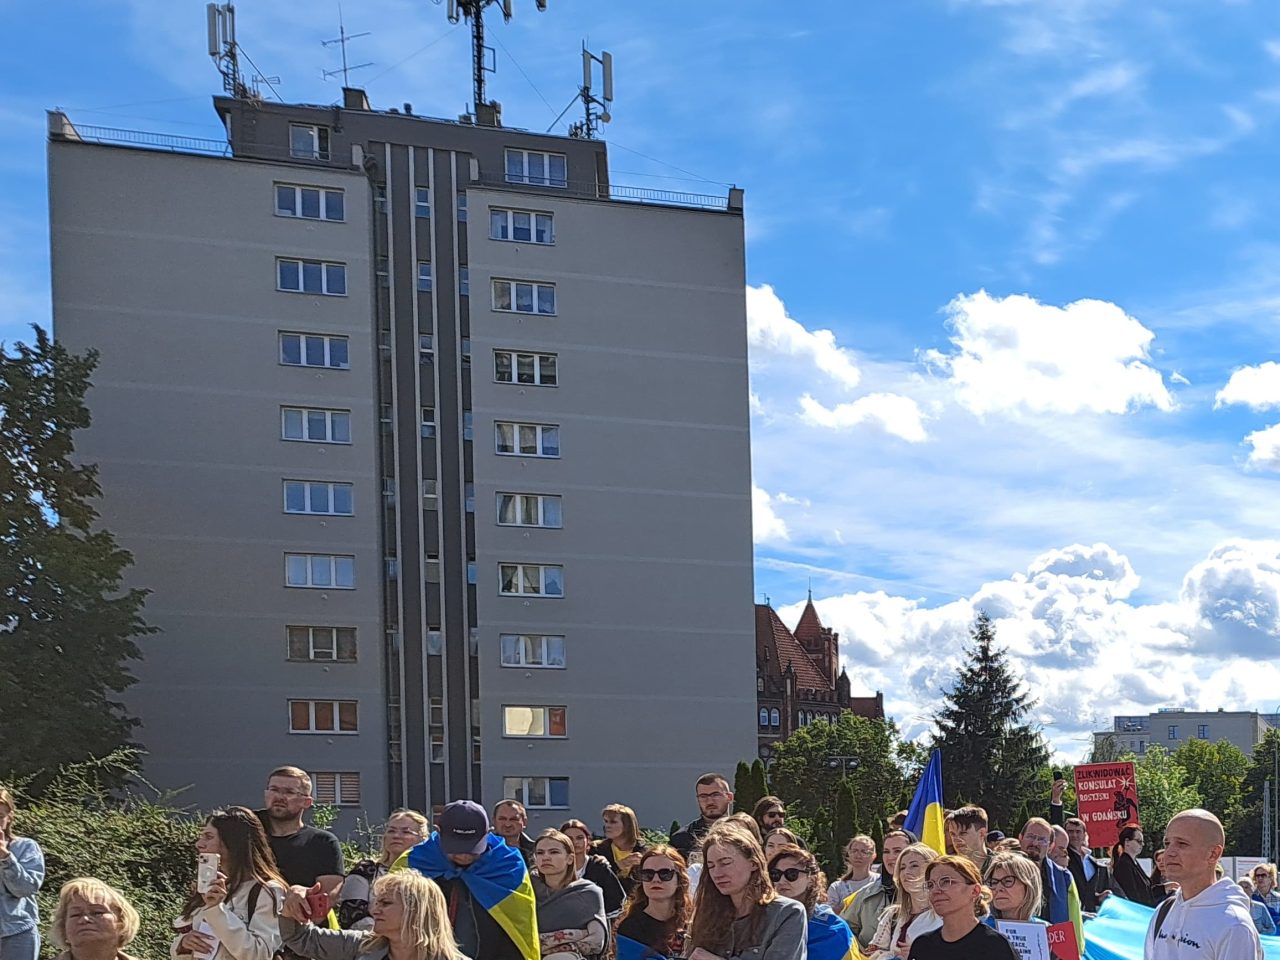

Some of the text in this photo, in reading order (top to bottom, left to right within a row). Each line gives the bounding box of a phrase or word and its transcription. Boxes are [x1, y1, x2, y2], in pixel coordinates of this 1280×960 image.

[1077, 765, 1131, 780] ZLIKWIDOWAĆ
[1078, 779, 1117, 791] KONSULAT
[1079, 792, 1110, 802] ROSYJSKI
[1081, 808, 1128, 822] W GDAŃSKU
